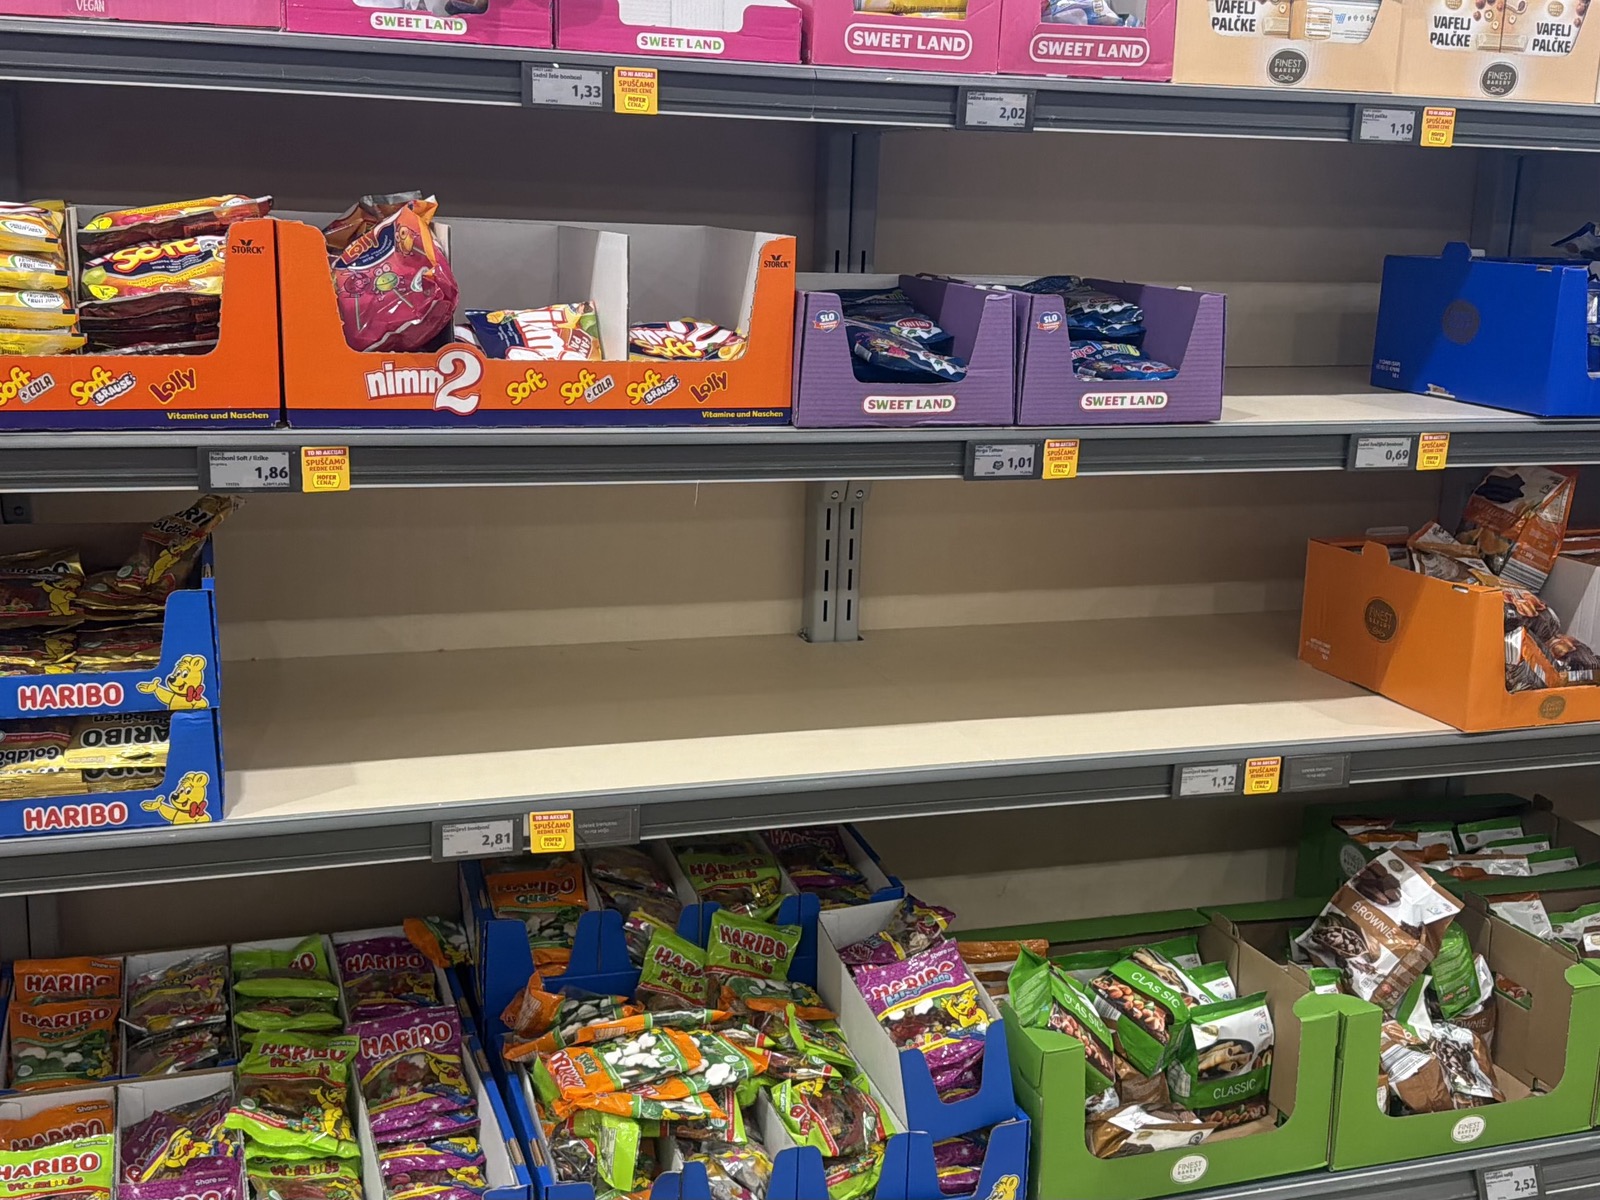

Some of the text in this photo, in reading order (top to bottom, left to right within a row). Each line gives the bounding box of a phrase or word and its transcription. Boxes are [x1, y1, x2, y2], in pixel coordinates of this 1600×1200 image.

[75, 0, 105, 12] VEGAN
[1215, 0, 1256, 15] VAFELJ
[374, 16, 464, 33] SWEET LAND
[1212, 14, 1257, 32] PALČKE
[1434, 16, 1472, 31] VAFELJ
[1536, 22, 1572, 37] VAFELJ
[640, 36, 723, 52] SWEET LAND
[852, 30, 966, 53] SWEET LAND
[1430, 32, 1472, 48] PALČKE
[1532, 38, 1571, 54] PALČKE
[1037, 40, 1144, 60] SWEET LAND
[1274, 58, 1302, 68] FINEST
[1487, 71, 1513, 80] FINEST
[618, 79, 655, 89] SPUŠČAMO
[572, 84, 601, 100] 1,33
[627, 96, 647, 104] HOFER
[999, 107, 1025, 121] 2,02
[1426, 117, 1453, 125] SPUŠČAMO
[1390, 123, 1413, 136] 1,19
[232, 246, 263, 254] STORCK
[763, 260, 789, 268] STORCK
[820, 313, 835, 322] SLO
[1044, 314, 1058, 323] SLO
[28, 375, 53, 397] COLA
[94, 375, 132, 402] BRAUSE
[150, 368, 196, 403] Lolly
[507, 368, 548, 404] Soft
[560, 368, 596, 404] Soft
[592, 378, 613, 396] COLA
[645, 377, 679, 404] BRAUSE
[690, 372, 729, 403] Lolly
[868, 398, 952, 412] SWEET LAND
[1084, 394, 1165, 407] SWEET LAND
[166, 411, 269, 420] Vitamine und Naschen
[752, 410, 784, 418] Naschen
[1047, 448, 1076, 456] SPUŠČAMO
[1385, 450, 1409, 462] 0,69
[305, 457, 346, 467] SPUŠČAMO
[1008, 457, 1032, 470] 1,01
[255, 467, 289, 481] 1,86
[18, 683, 124, 710] HARIBO
[82, 726, 170, 748] ARIBO
[1249, 766, 1277, 774] SPUŠČAMO
[1212, 776, 1234, 788] 1,12
[24, 803, 127, 830] HARIBO
[533, 820, 571, 829] SPUŠČAMO
[482, 832, 511, 847] 2,81
[1351, 900, 1397, 941] BROWNIE
[720, 924, 788, 960] HARIBO
[346, 954, 424, 973] HARIBO
[1131, 971, 1181, 1010] CLASSIC
[21, 1008, 113, 1031] HARIBO
[1456, 1018, 1487, 1029] OWNIE
[360, 1022, 452, 1060] HARIBO
[1214, 1078, 1257, 1100] CLASSIC
[1458, 1121, 1482, 1131] FINEST
[1177, 1160, 1203, 1171] FINEST
[195, 1178, 217, 1186] Share
[1514, 1178, 1537, 1192] 2,52
